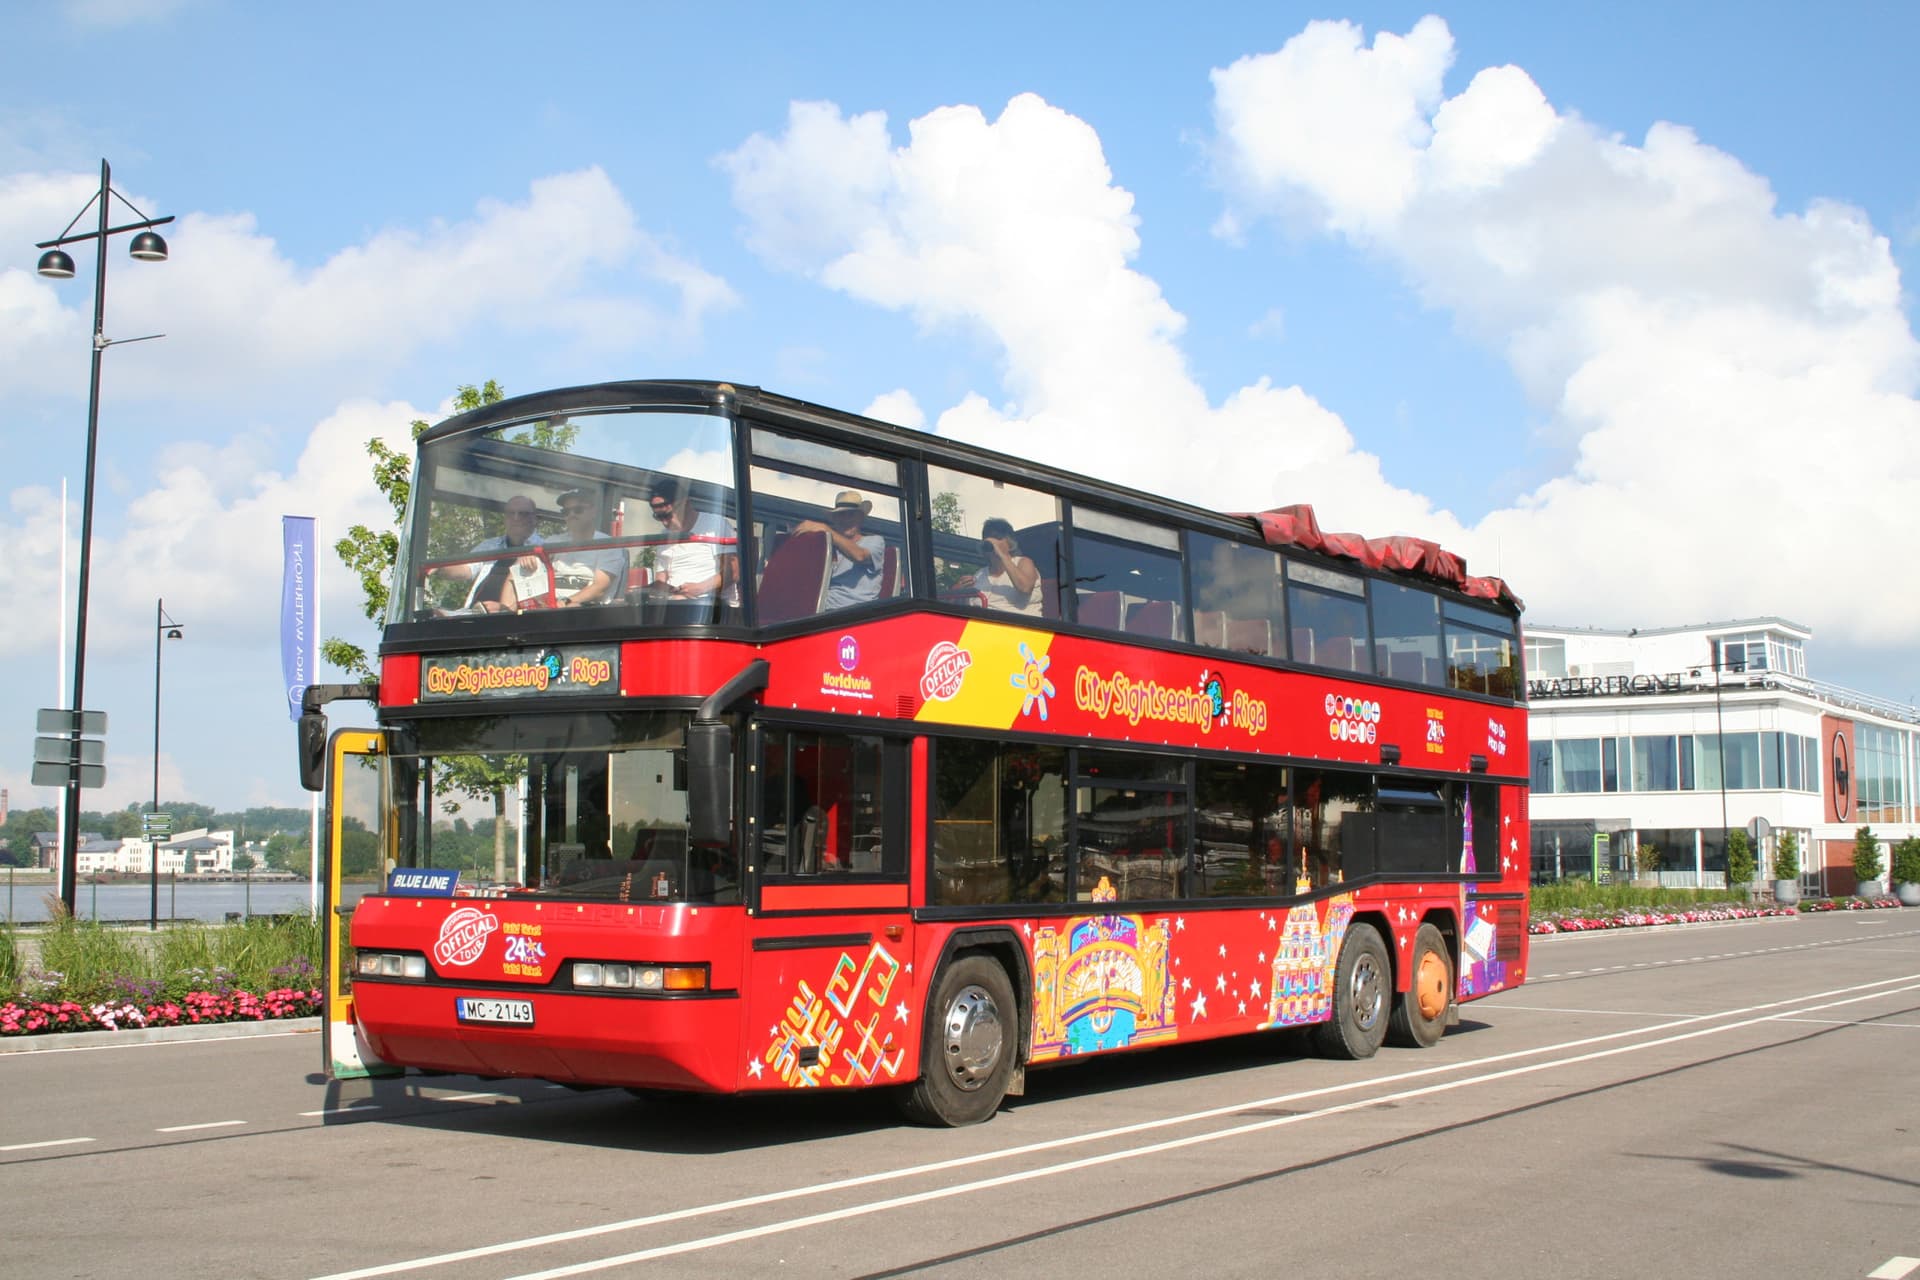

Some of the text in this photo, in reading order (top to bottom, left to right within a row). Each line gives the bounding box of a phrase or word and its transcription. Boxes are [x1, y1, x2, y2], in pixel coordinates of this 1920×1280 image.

[571, 657, 609, 686] Riga
[926, 653, 968, 693] OFFICIAL
[1528, 672, 1686, 697] WATERFRONT
[942, 676, 961, 696] TOUR
[1233, 689, 1267, 736] Riga
[393, 875, 450, 890] BLUE LINE
[441, 915, 494, 958] OFFICIAL
[504, 935, 527, 962] 24
[459, 940, 484, 961] TOUR
[466, 1002, 530, 1021] MC-2149
